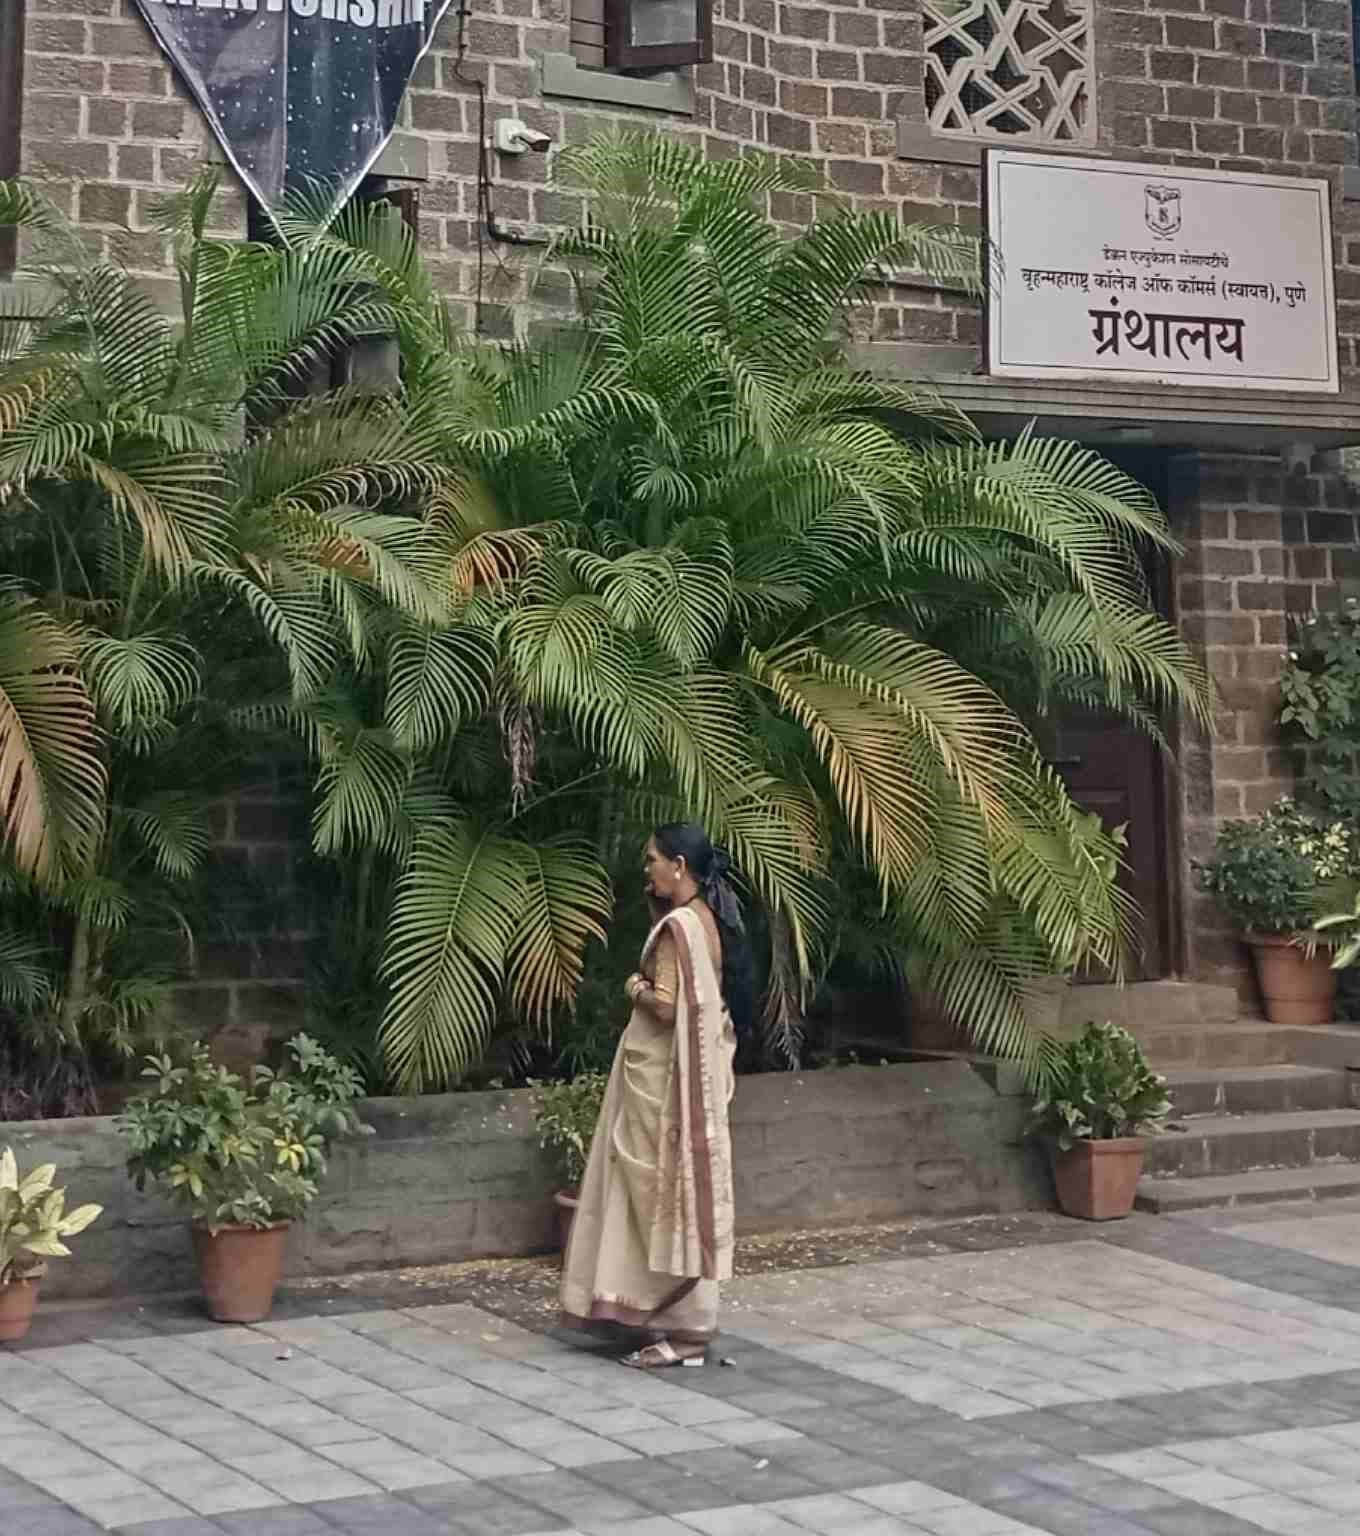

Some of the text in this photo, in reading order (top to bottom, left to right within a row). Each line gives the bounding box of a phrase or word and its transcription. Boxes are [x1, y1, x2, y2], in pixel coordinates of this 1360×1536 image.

[1093, 268, 1137, 292] कॉलेज
[1142, 273, 1174, 295] ऑफ
[1177, 274, 1217, 297] कॉमर्स
[1284, 280, 1307, 308] पुणे
[1088, 296, 1246, 362] ग्रंथालय
